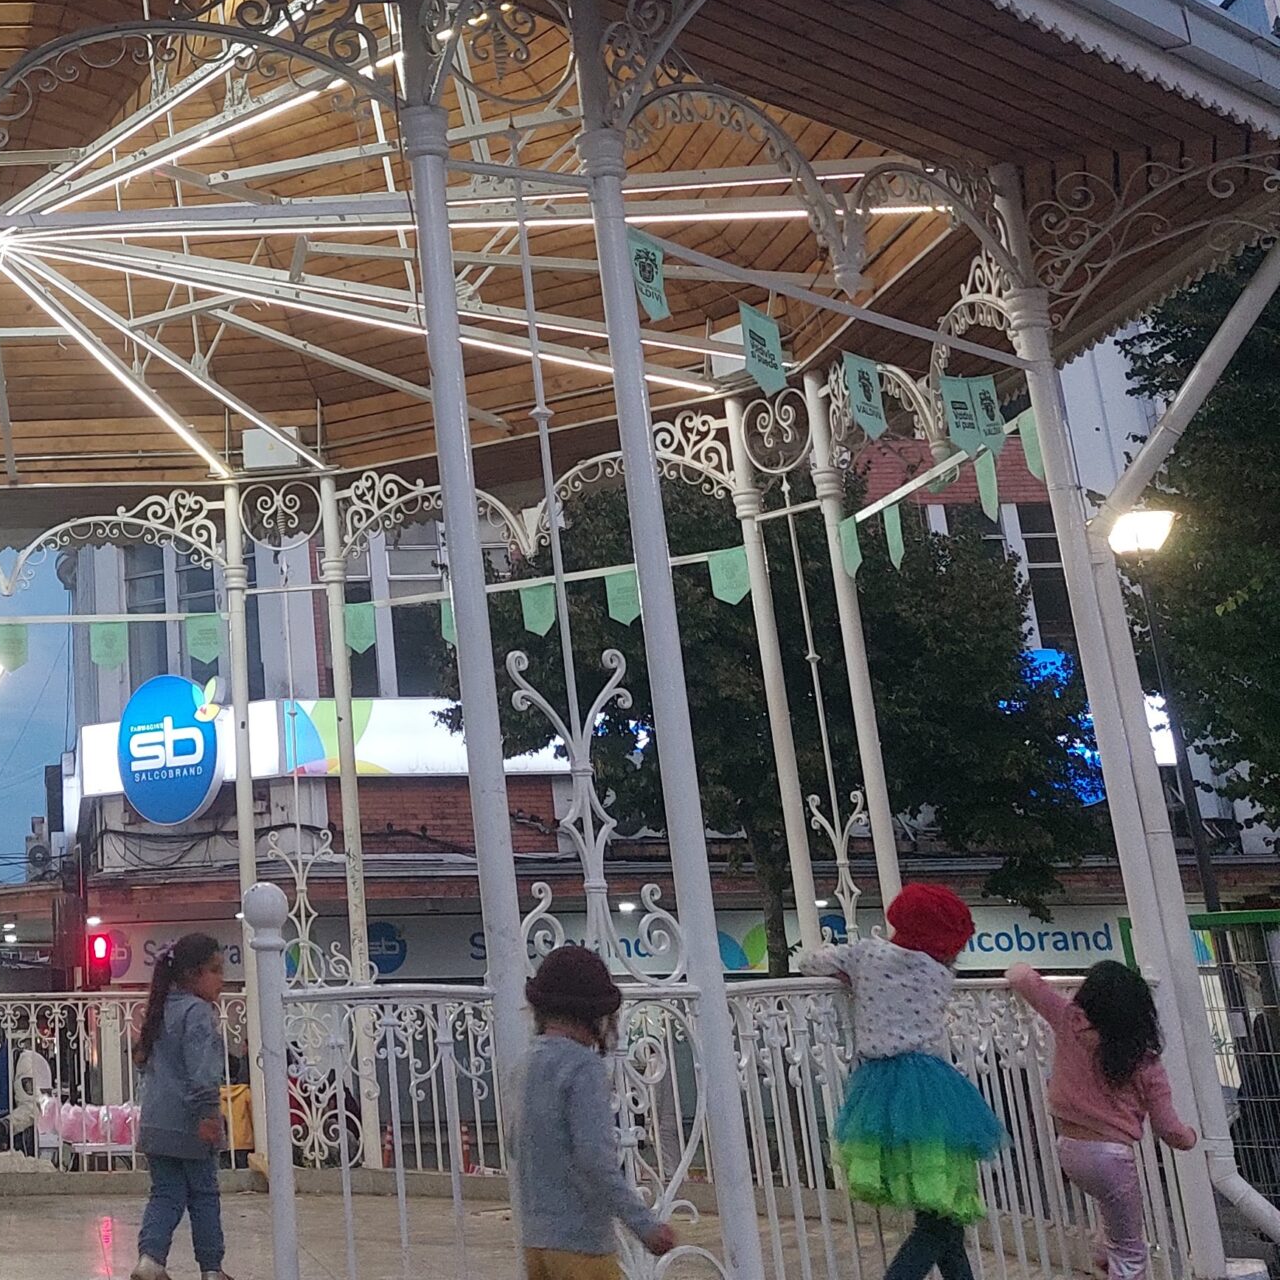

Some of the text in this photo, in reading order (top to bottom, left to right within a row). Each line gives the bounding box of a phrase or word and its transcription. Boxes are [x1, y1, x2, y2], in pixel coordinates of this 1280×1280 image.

[129, 715, 204, 772] sb
[134, 766, 203, 782] SALCOBRAND
[963, 923, 1113, 952] cobrand
